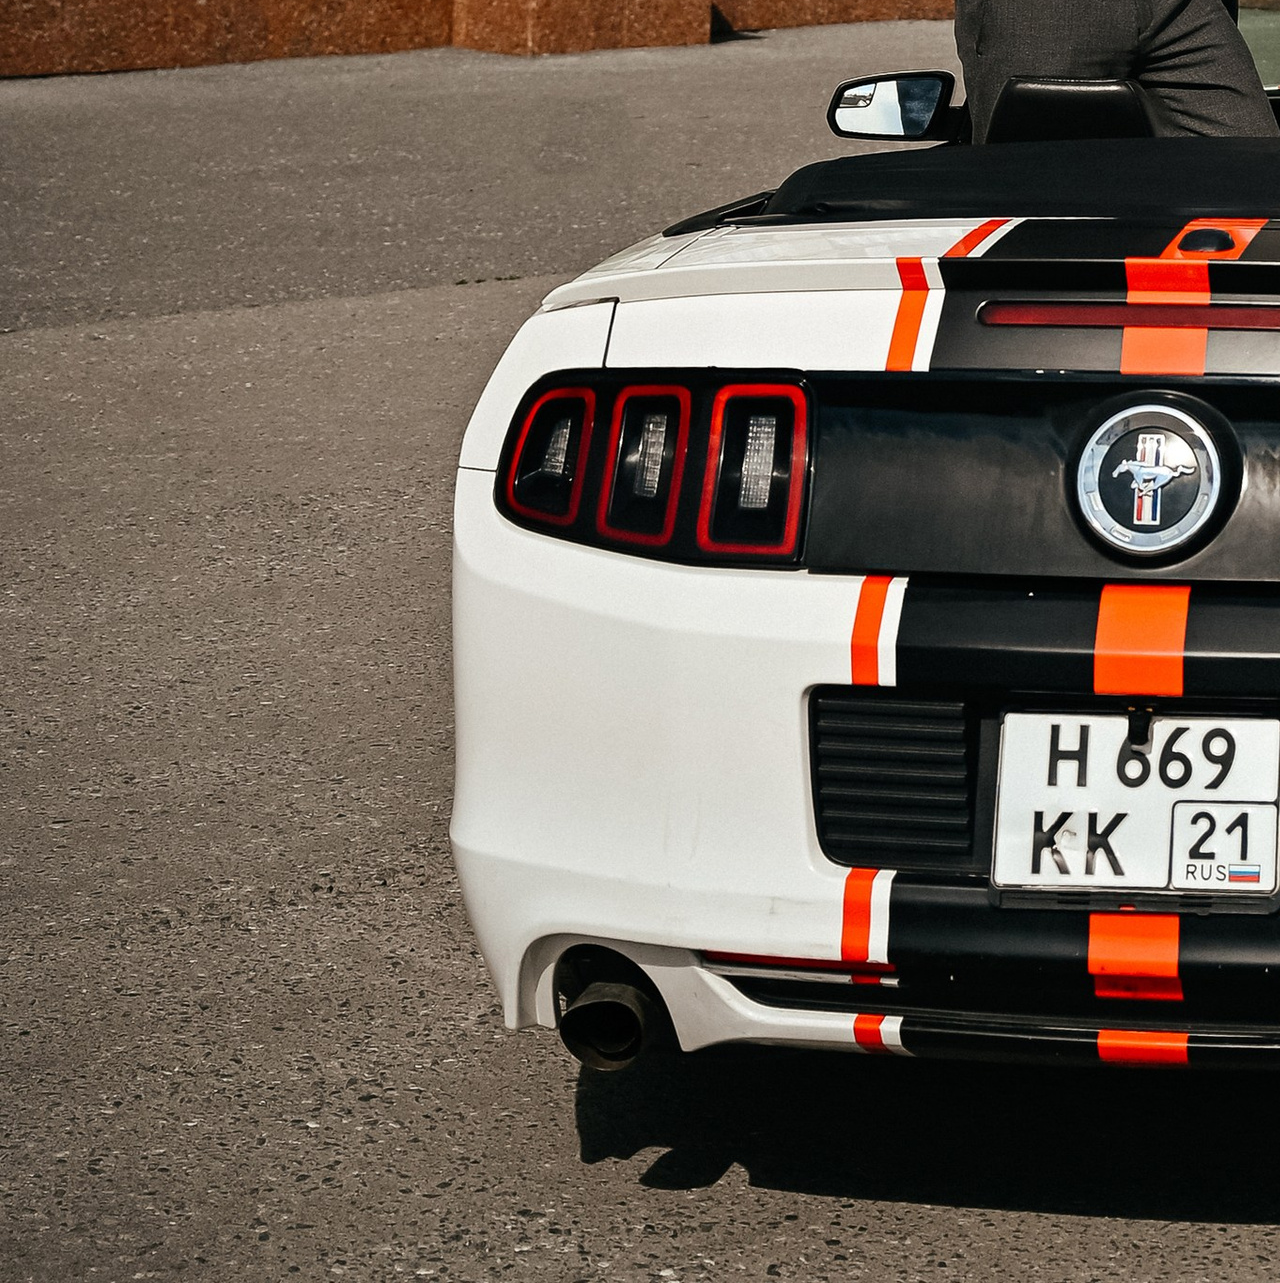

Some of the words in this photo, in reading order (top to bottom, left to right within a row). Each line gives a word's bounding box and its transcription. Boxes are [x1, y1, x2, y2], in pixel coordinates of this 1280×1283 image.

[1116, 727, 1236, 790] 669
[1188, 811, 1250, 861] 21
[1185, 864, 1227, 881] RUS
